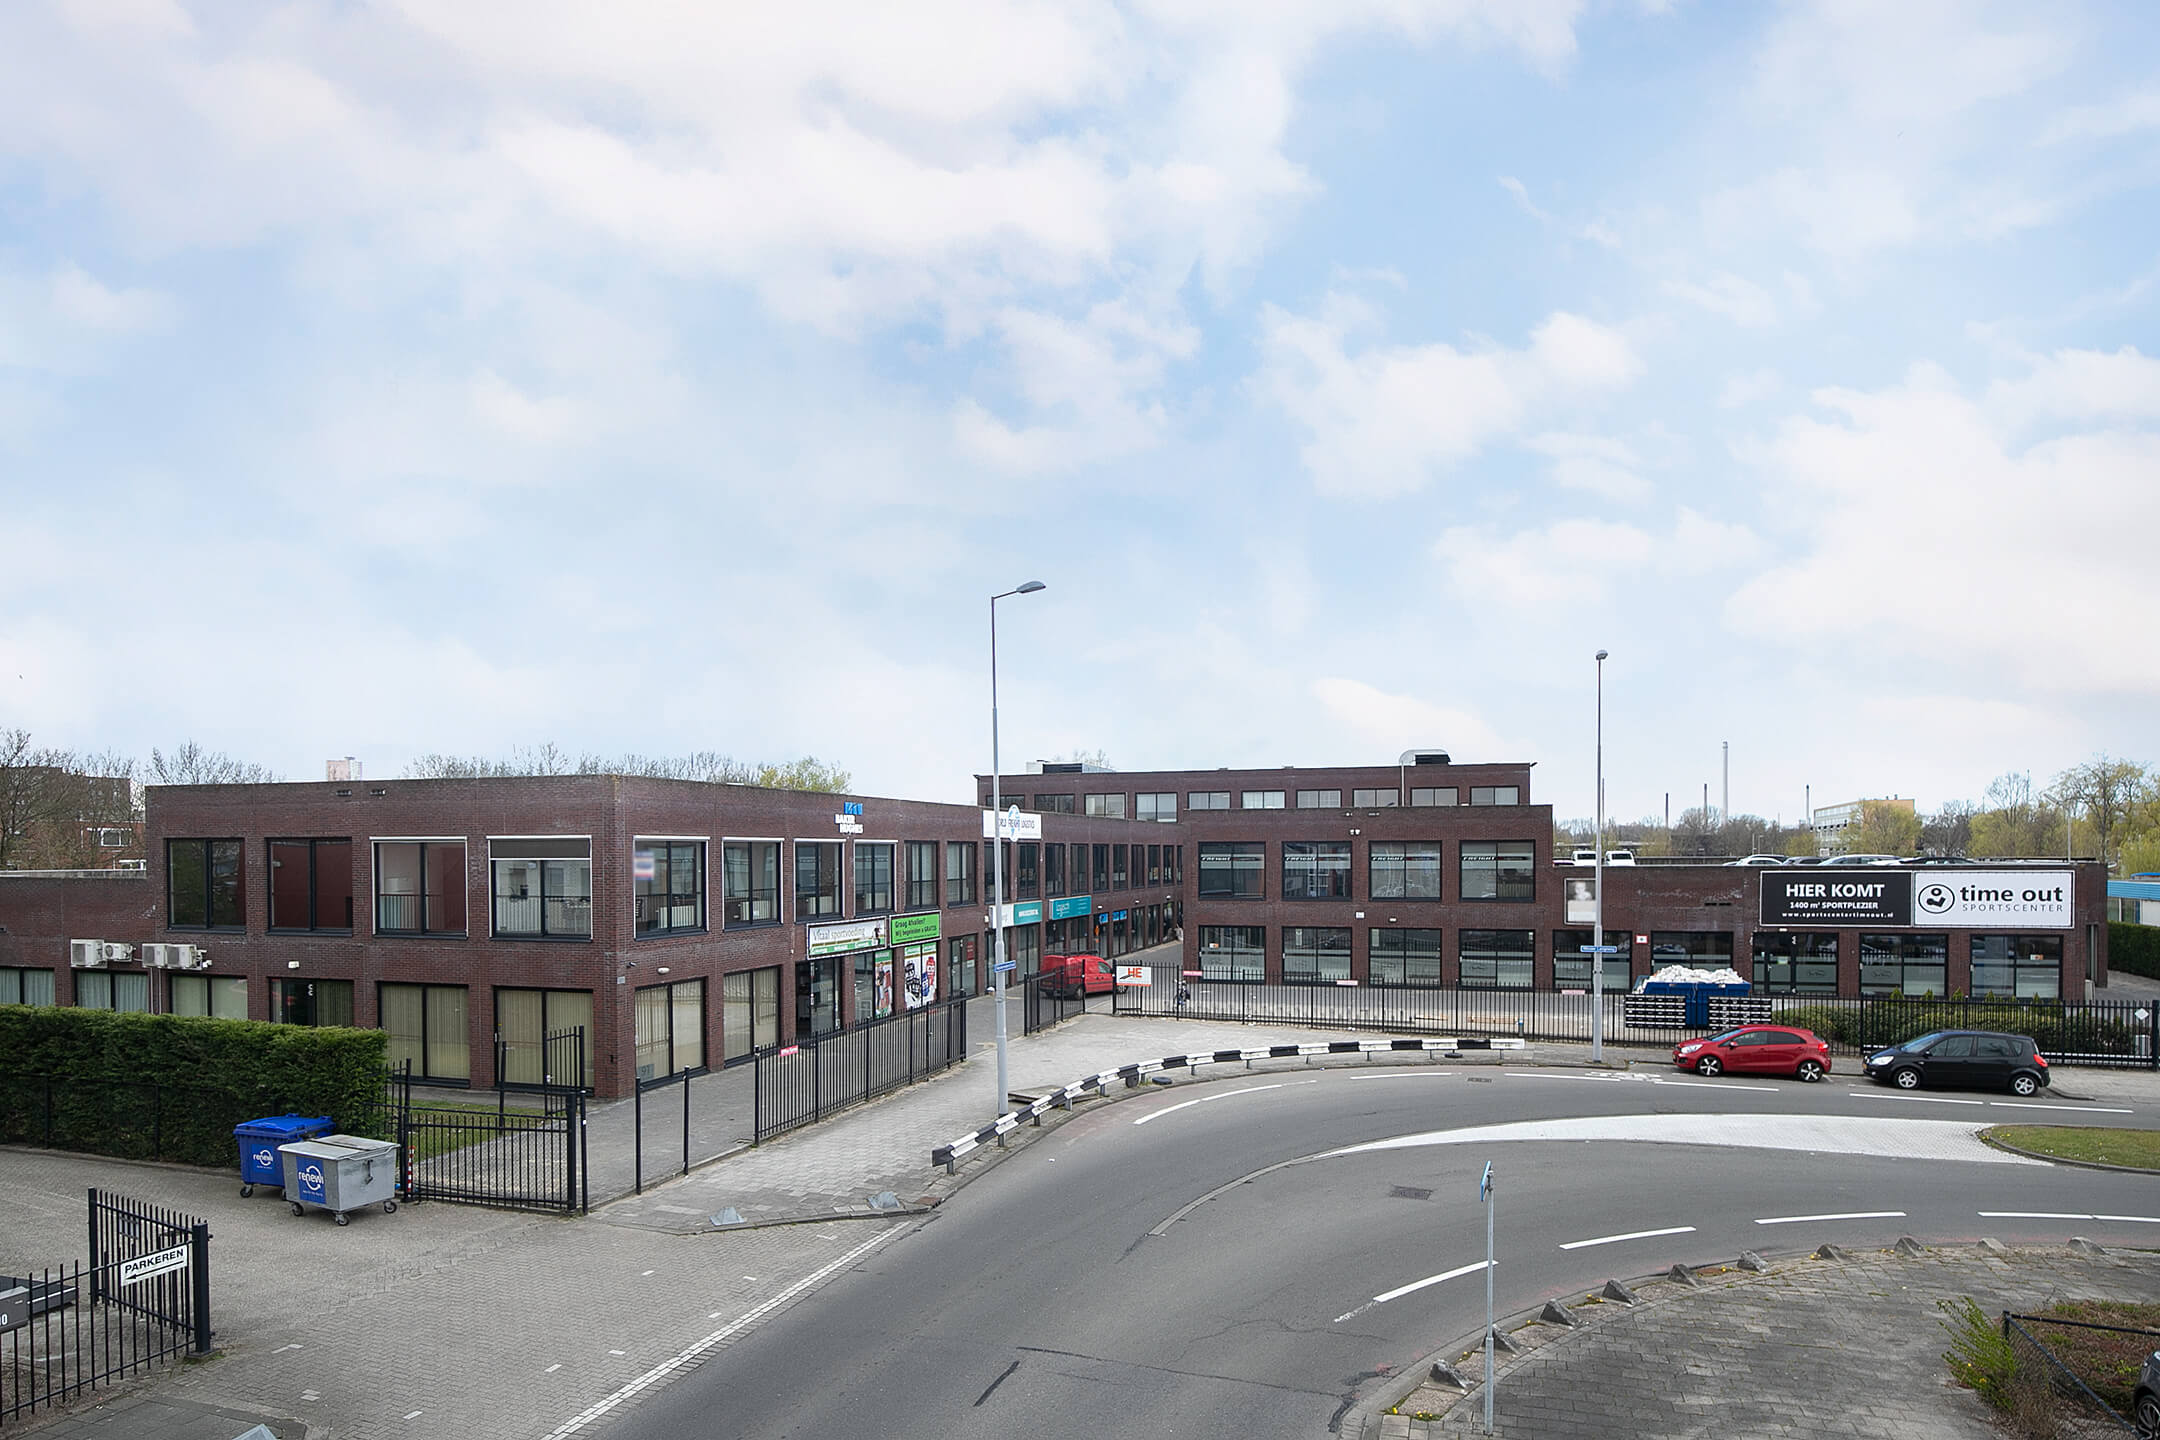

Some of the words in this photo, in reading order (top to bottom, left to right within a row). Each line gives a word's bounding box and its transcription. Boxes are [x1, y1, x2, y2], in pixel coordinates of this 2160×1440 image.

[1786, 884, 1827, 897] HIER
[1831, 884, 1885, 897] KOMT
[1959, 885, 2014, 901] time
[2022, 887, 2063, 901] out
[1962, 903, 2063, 912] SPORTSCENTER
[1128, 967, 1142, 978] HE
[125, 1248, 184, 1274] PARKEREN
[0, 1313, 8, 1326] 0
